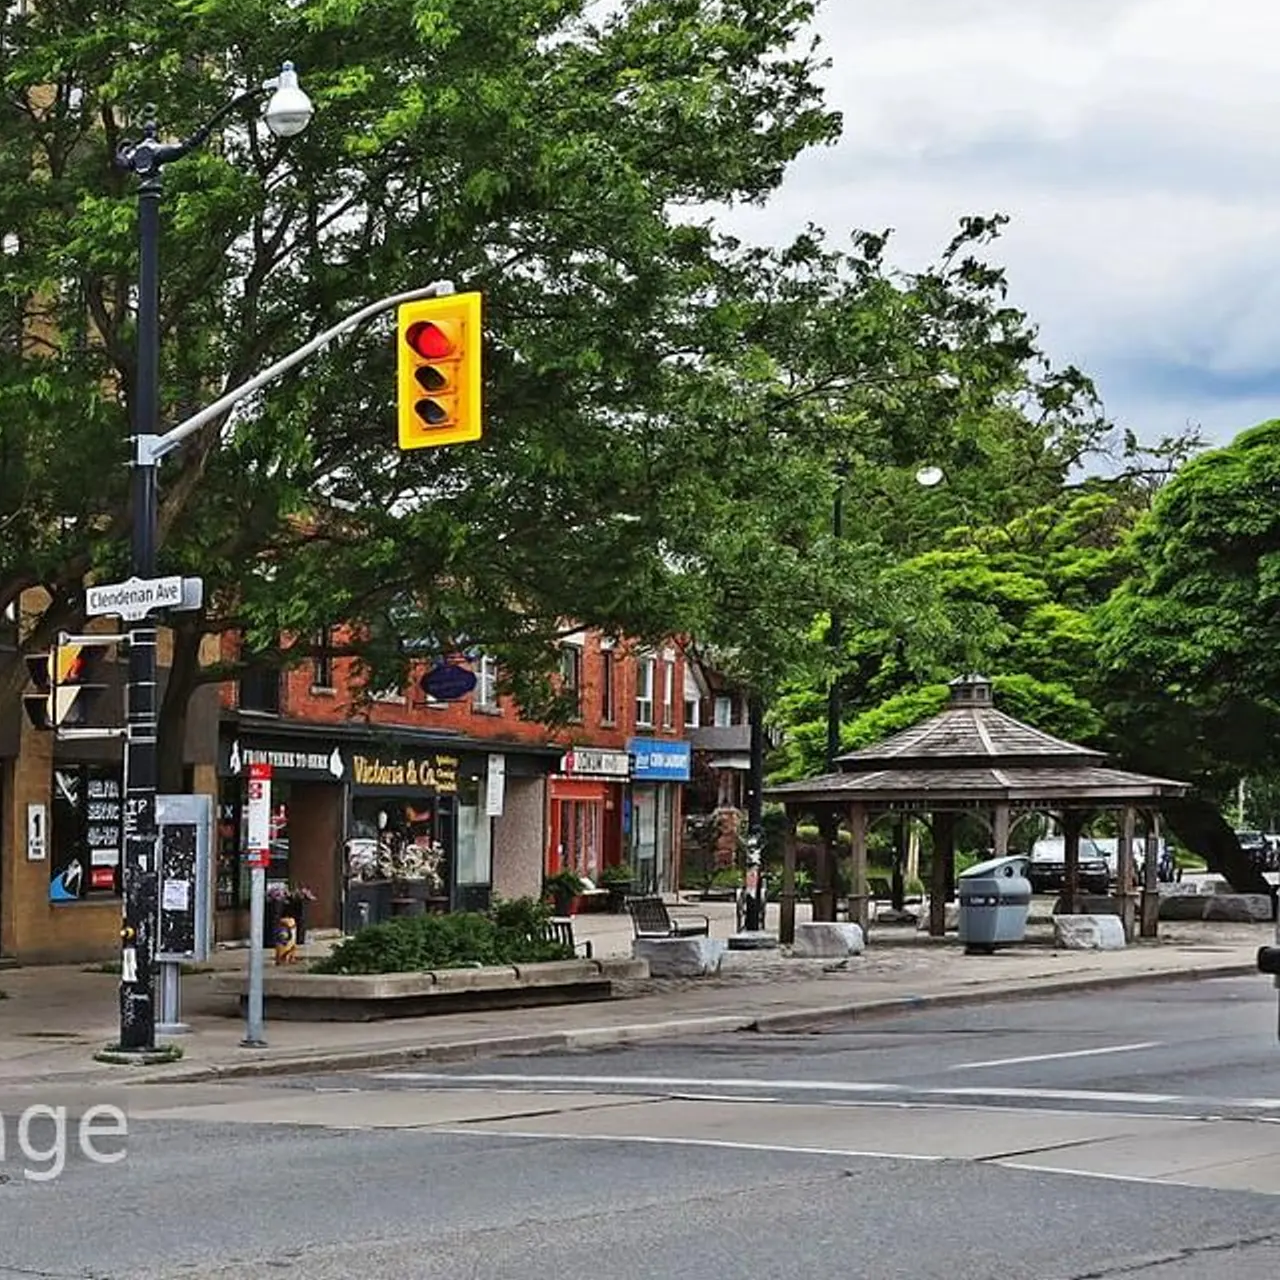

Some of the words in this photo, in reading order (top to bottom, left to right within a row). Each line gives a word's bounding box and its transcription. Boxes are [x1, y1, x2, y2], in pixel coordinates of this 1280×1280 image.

[89, 588, 153, 609] Clendenan
[156, 584, 178, 600] Ave
[242, 749, 268, 765] FROM
[352, 755, 405, 785] Victoria
[406, 758, 418, 785] &
